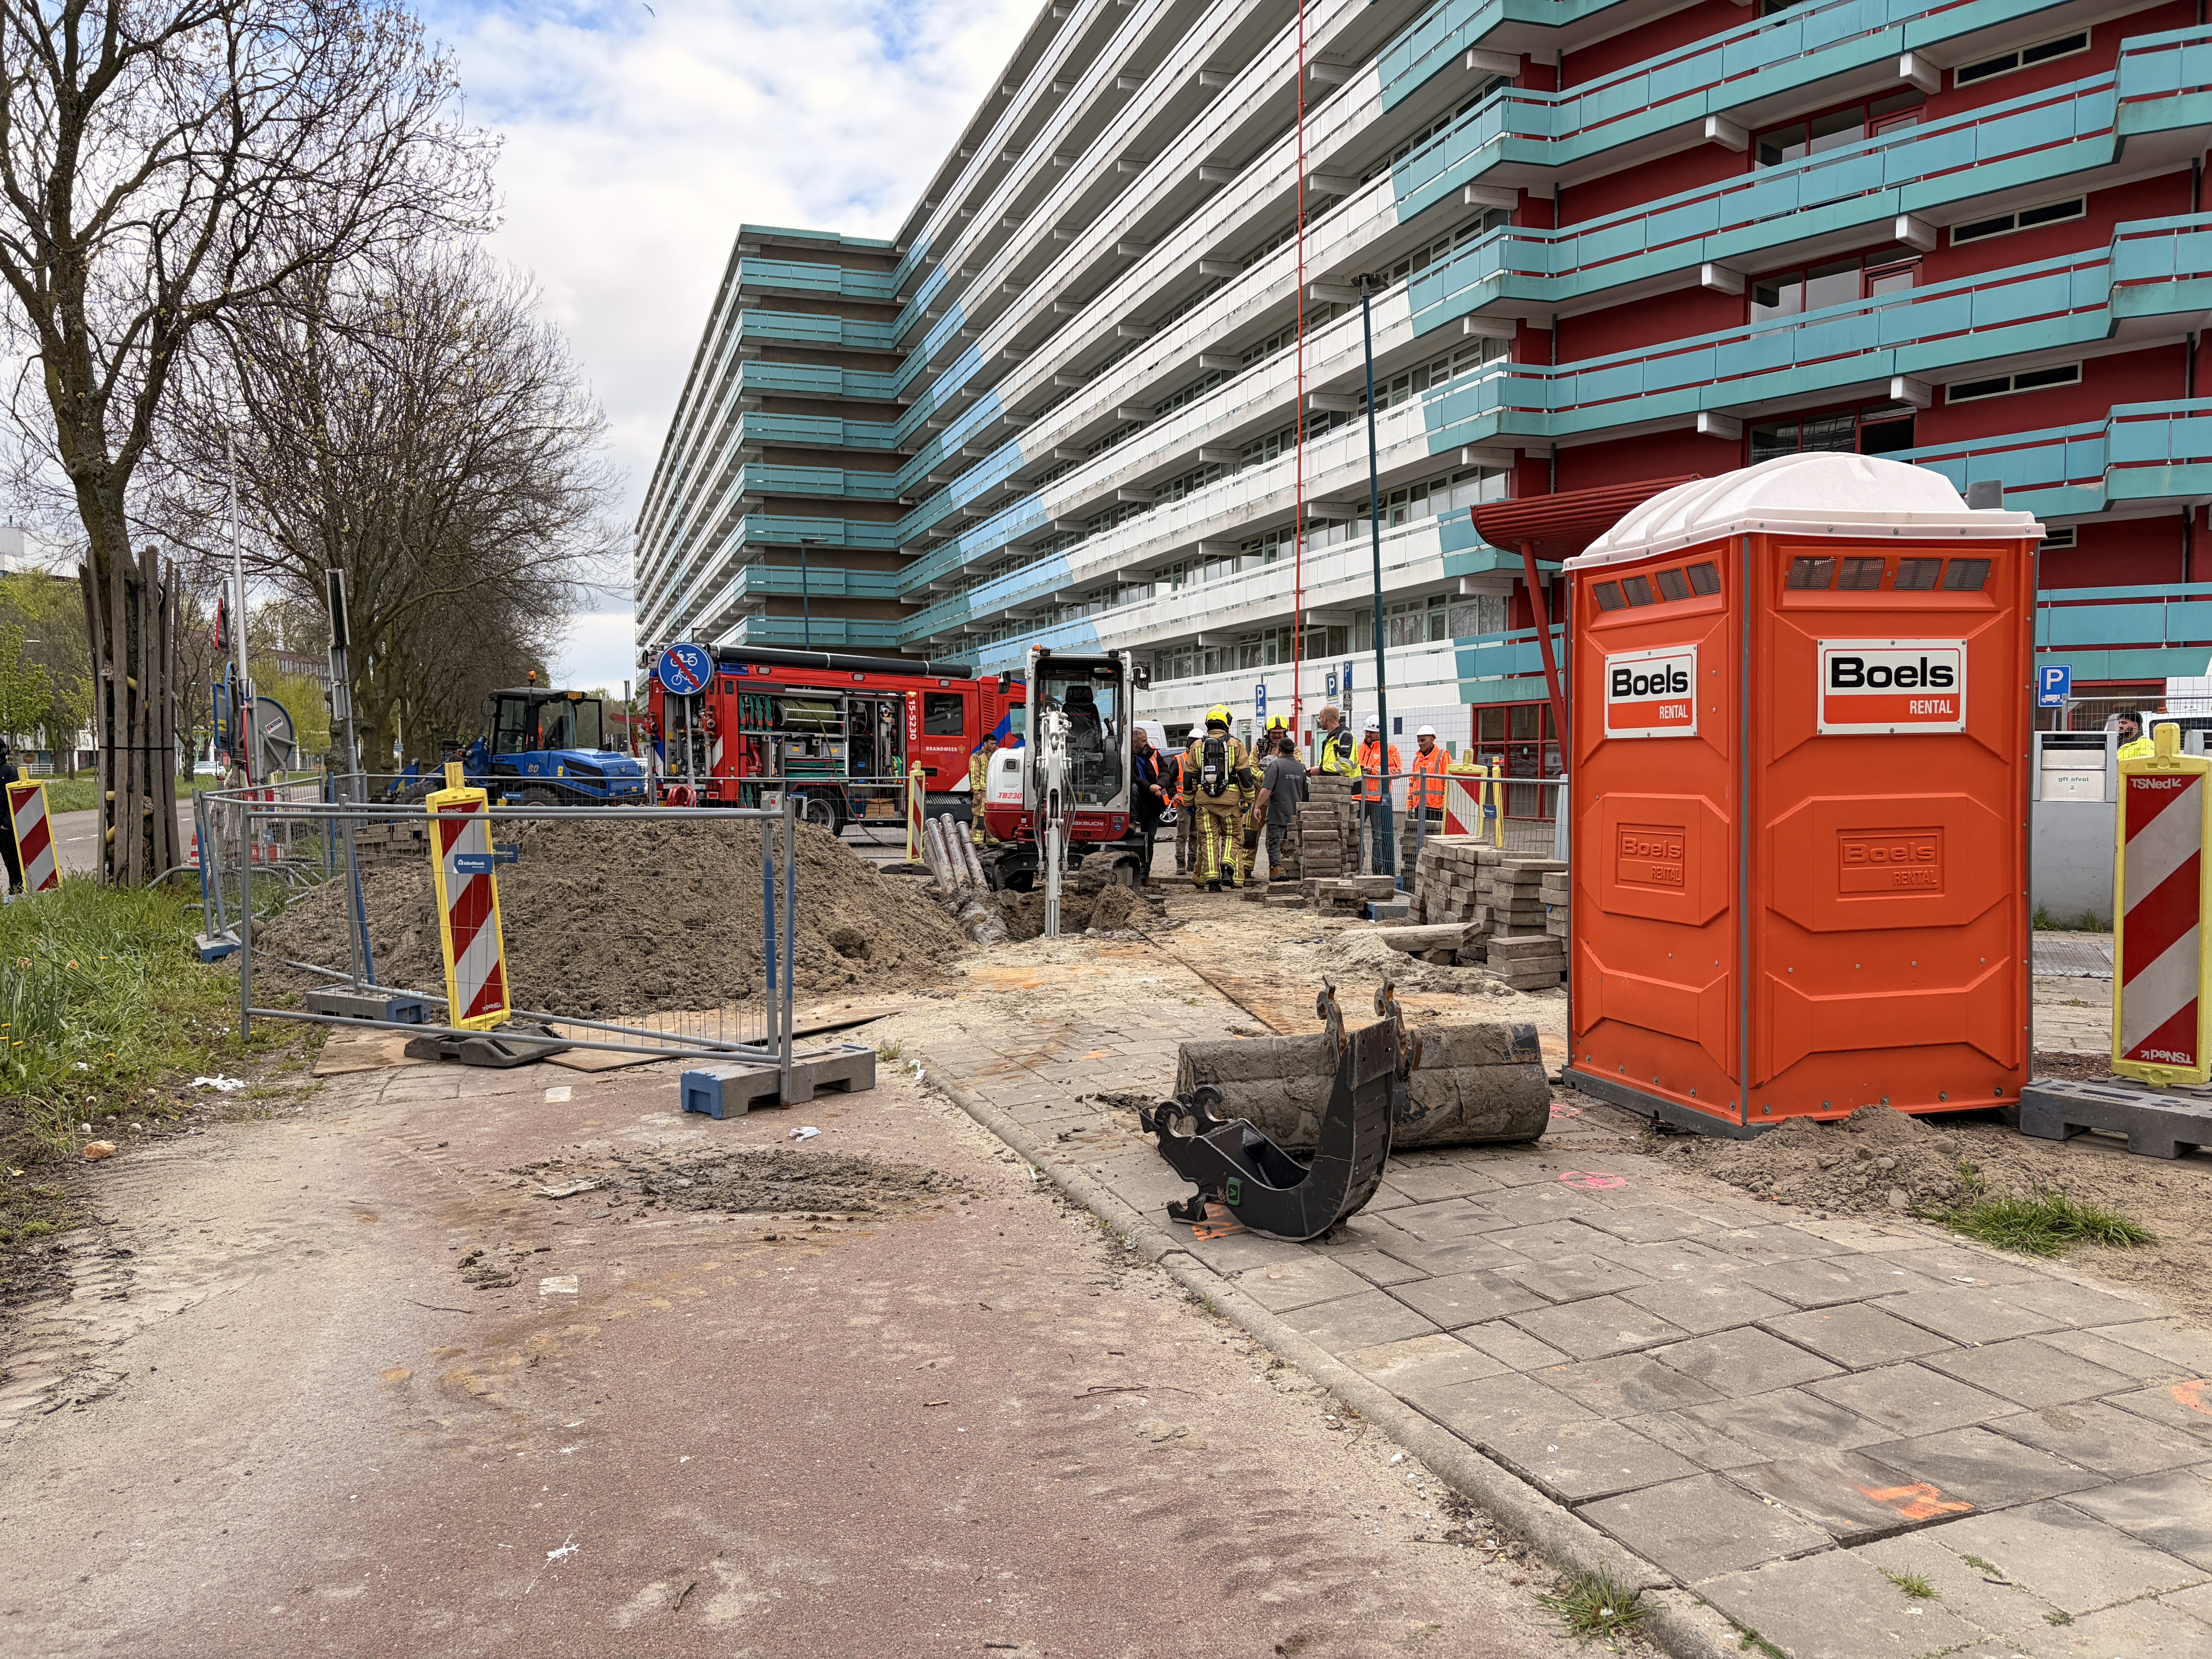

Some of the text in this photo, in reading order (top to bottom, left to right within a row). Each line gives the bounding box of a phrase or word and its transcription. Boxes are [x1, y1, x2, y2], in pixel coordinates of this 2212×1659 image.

[1345, 663, 1350, 678] P
[1832, 657, 1954, 688] Boels
[2046, 669, 2064, 690] P
[1329, 677, 1335, 695] P
[1612, 664, 1688, 697] Boels
[1257, 686, 1264, 705] P
[1659, 704, 1688, 719] RENTAL
[1910, 700, 1953, 714] RENTAL
[908, 700, 917, 740] 15-5230
[2130, 778, 2171, 789] TSNed
[1622, 837, 1682, 859] Boels
[1843, 842, 1934, 864] Boels
[1651, 866, 1681, 882] RENTAL
[1893, 870, 1937, 886] RENTAL
[2150, 1049, 2193, 1064] TSNed
